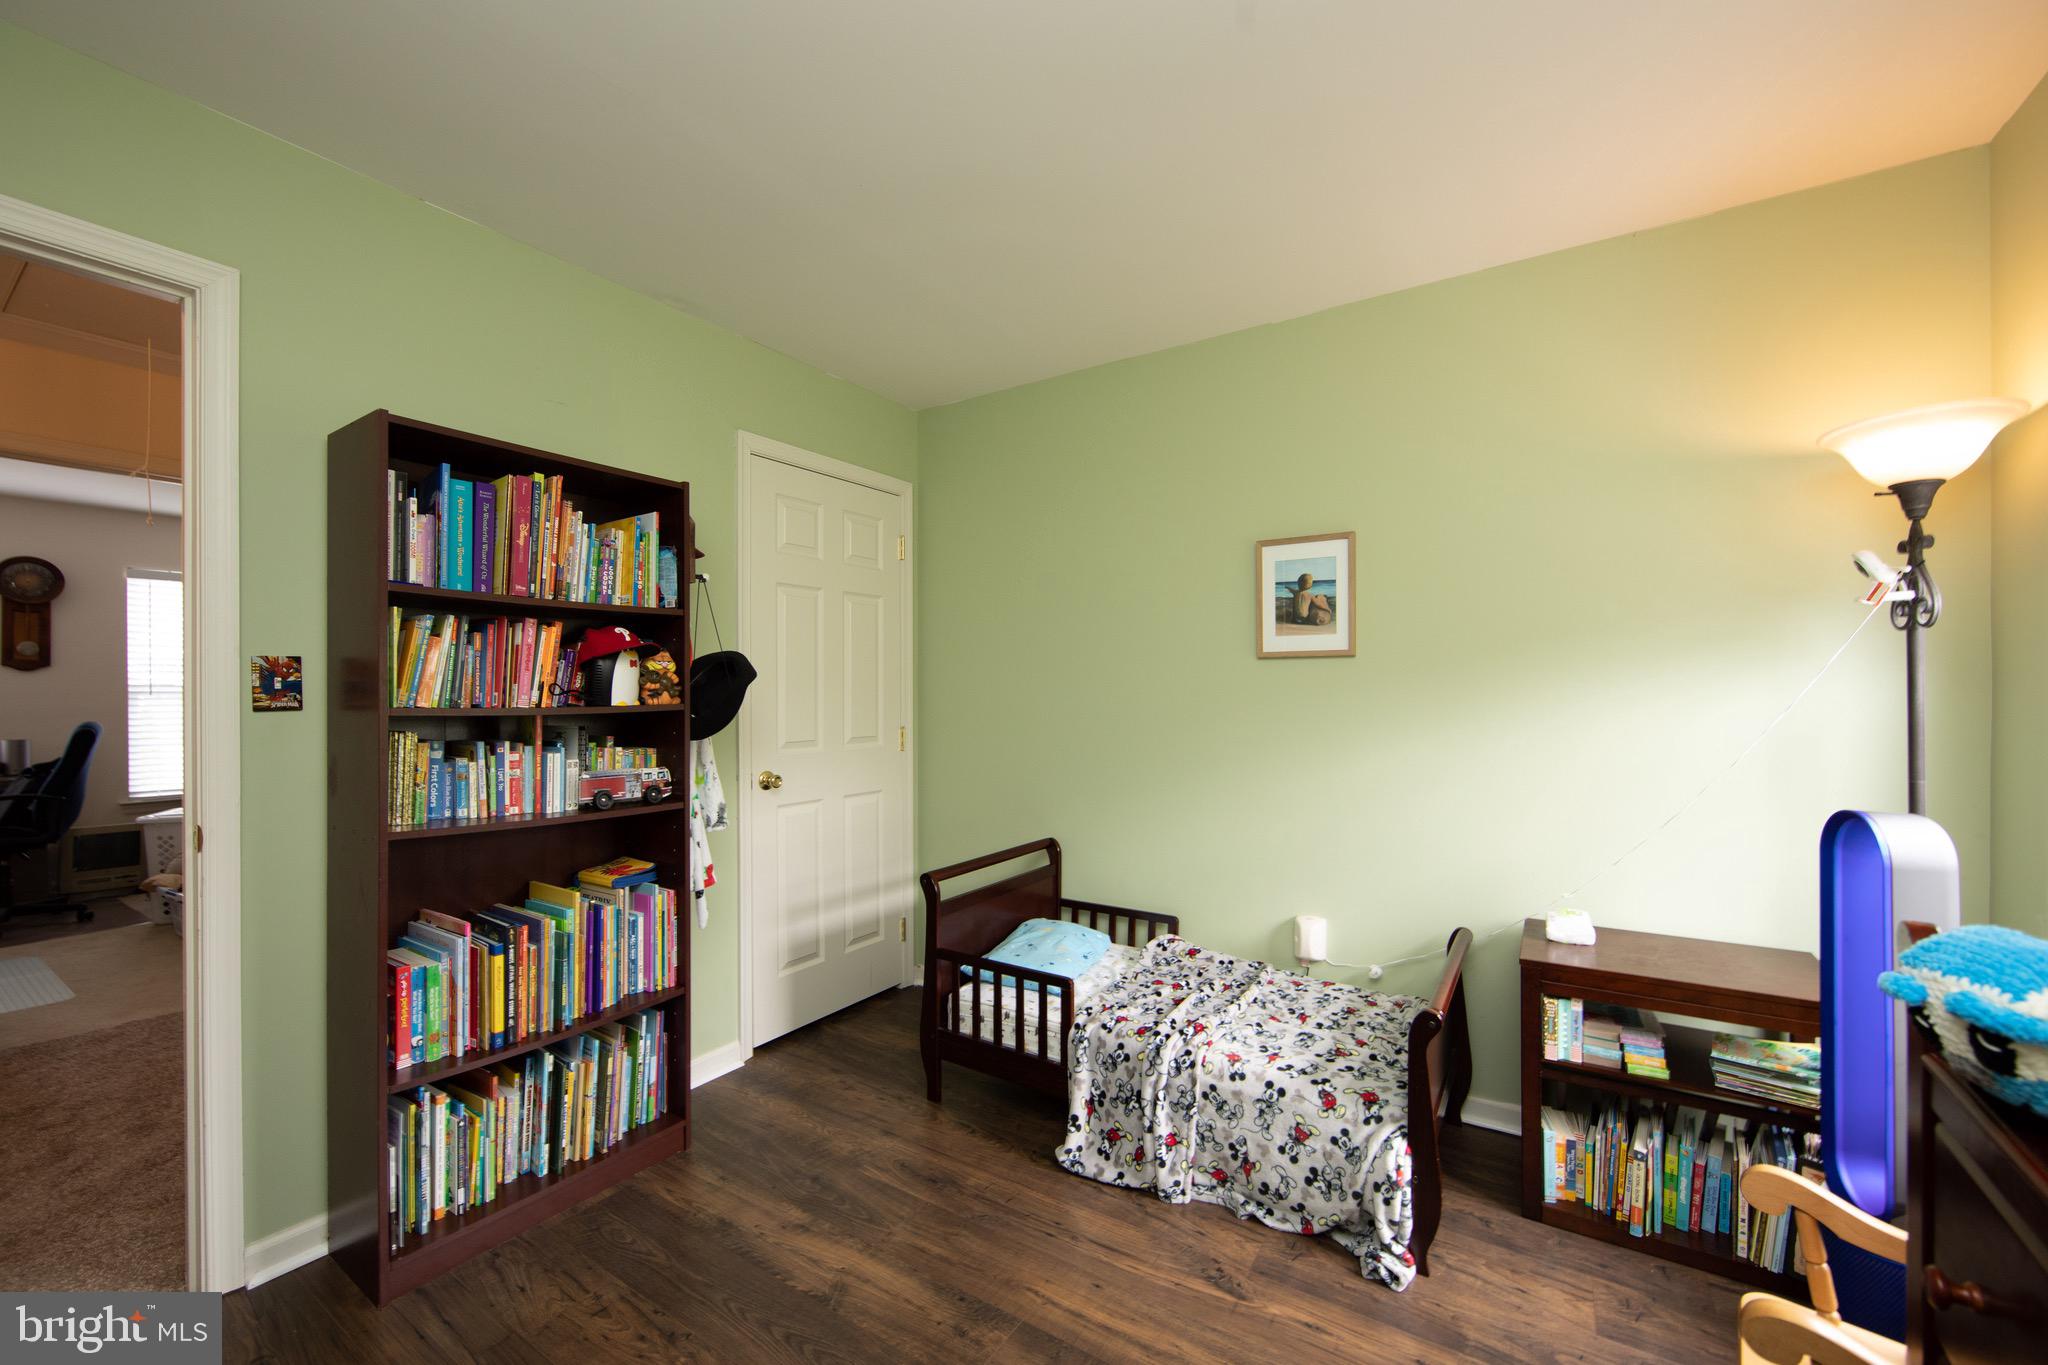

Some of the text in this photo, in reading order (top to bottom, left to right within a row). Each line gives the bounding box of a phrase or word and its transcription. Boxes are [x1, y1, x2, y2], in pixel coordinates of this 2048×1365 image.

[482, 512, 490, 543] Wonderful
[481, 543, 489, 564] Wizard
[429, 764, 439, 808] First Colors
